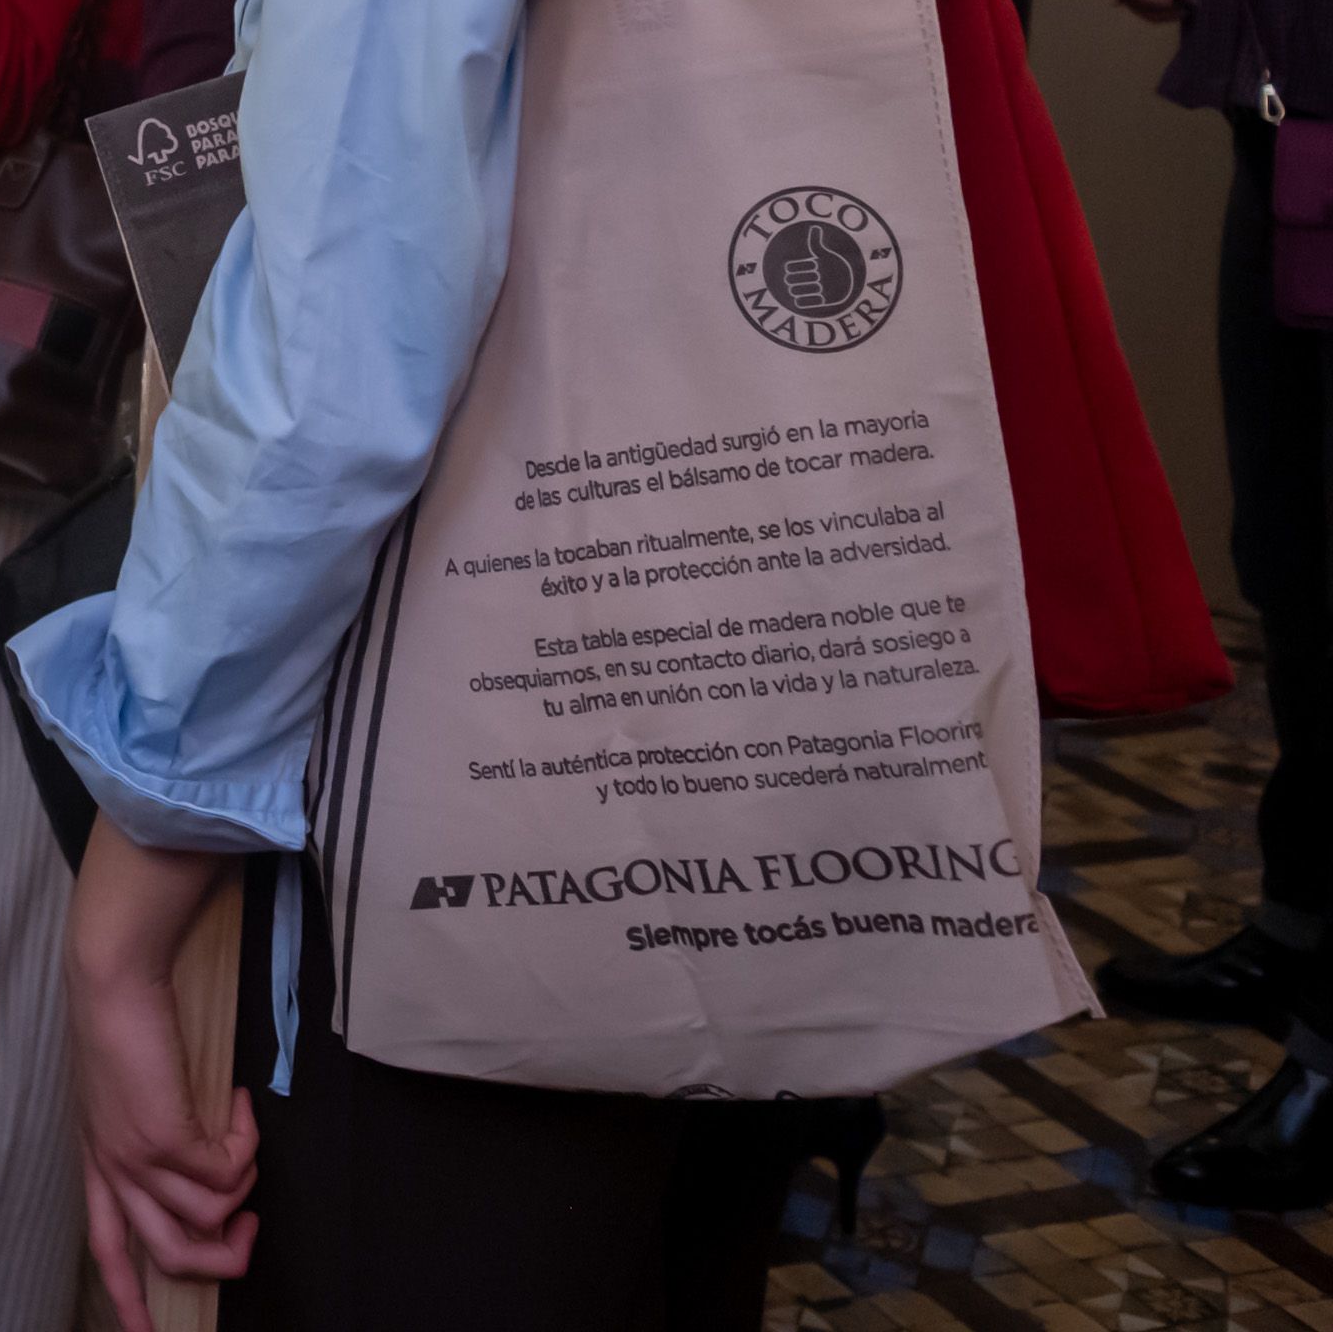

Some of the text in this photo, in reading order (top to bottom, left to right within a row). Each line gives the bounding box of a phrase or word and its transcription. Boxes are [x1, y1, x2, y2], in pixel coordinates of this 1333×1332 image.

[144, 160, 187, 187] FSC
[742, 192, 869, 242] TOCO
[742, 274, 894, 347] MADERA
[525, 409, 930, 480] Desde la antigüedad surgió en la mayoría
[514, 442, 935, 512] de las culturas el bálsamo de tocar madera.
[443, 500, 945, 578] A quienes la tocaban ritualmente, se los vinculaba al
[540, 531, 951, 598] éxito y a la protección ante la adversidad.
[534, 594, 967, 658] Esta tabla especial de madera noble que te
[469, 628, 972, 693] obsequiamos, en su contacto diario, dará sosiego a
[542, 658, 980, 718] tu alma en unión con la vida y la naturaleza.
[468, 758, 517, 781] Sentí
[518, 757, 537, 778] la
[540, 748, 634, 777] auténtica
[636, 740, 740, 769] protección
[743, 741, 784, 759] con
[786, 729, 895, 757] Patagonia
[595, 783, 609, 805] y
[612, 774, 658, 797] todo
[660, 774, 680, 795] lo
[681, 773, 750, 795] bueno
[754, 763, 850, 790] sucederá
[479, 857, 753, 908] PATAGONIA
[742, 914, 828, 947] tocás
[830, 910, 926, 937] buena
